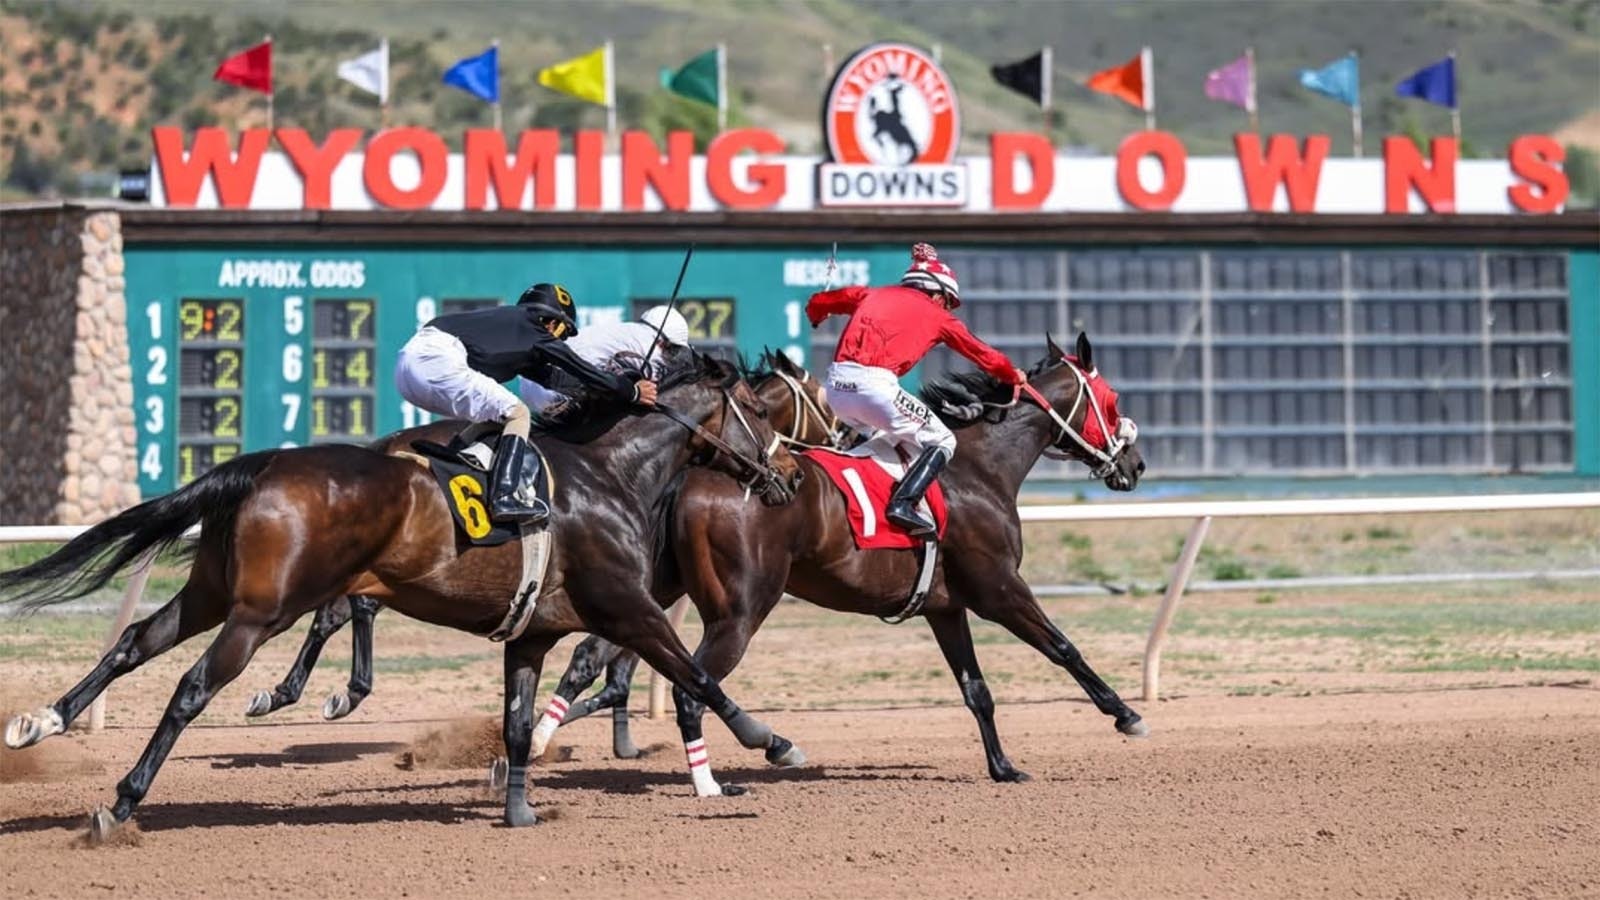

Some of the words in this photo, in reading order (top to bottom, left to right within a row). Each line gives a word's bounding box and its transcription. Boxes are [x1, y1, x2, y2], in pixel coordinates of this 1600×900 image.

[835, 52, 951, 114] WYOMING
[151, 126, 788, 211] WYOMING
[991, 131, 1569, 214] DOWNS
[831, 171, 958, 198] DOWNS
[218, 260, 307, 288] APPROX.
[310, 260, 366, 288] ODDS
[554, 285, 572, 306] 6
[147, 302, 162, 340] 1
[180, 303, 241, 341] 9:2
[283, 297, 304, 335] 5
[346, 303, 372, 340] 7
[785, 301, 800, 338] 1
[147, 346, 167, 384] 2
[214, 351, 240, 390] 2
[282, 344, 303, 382] 6
[146, 396, 165, 434] 3
[214, 399, 239, 437] 2
[281, 394, 301, 432] 7
[142, 443, 162, 481] 4
[450, 474, 492, 539] 6
[842, 467, 876, 537] 1
